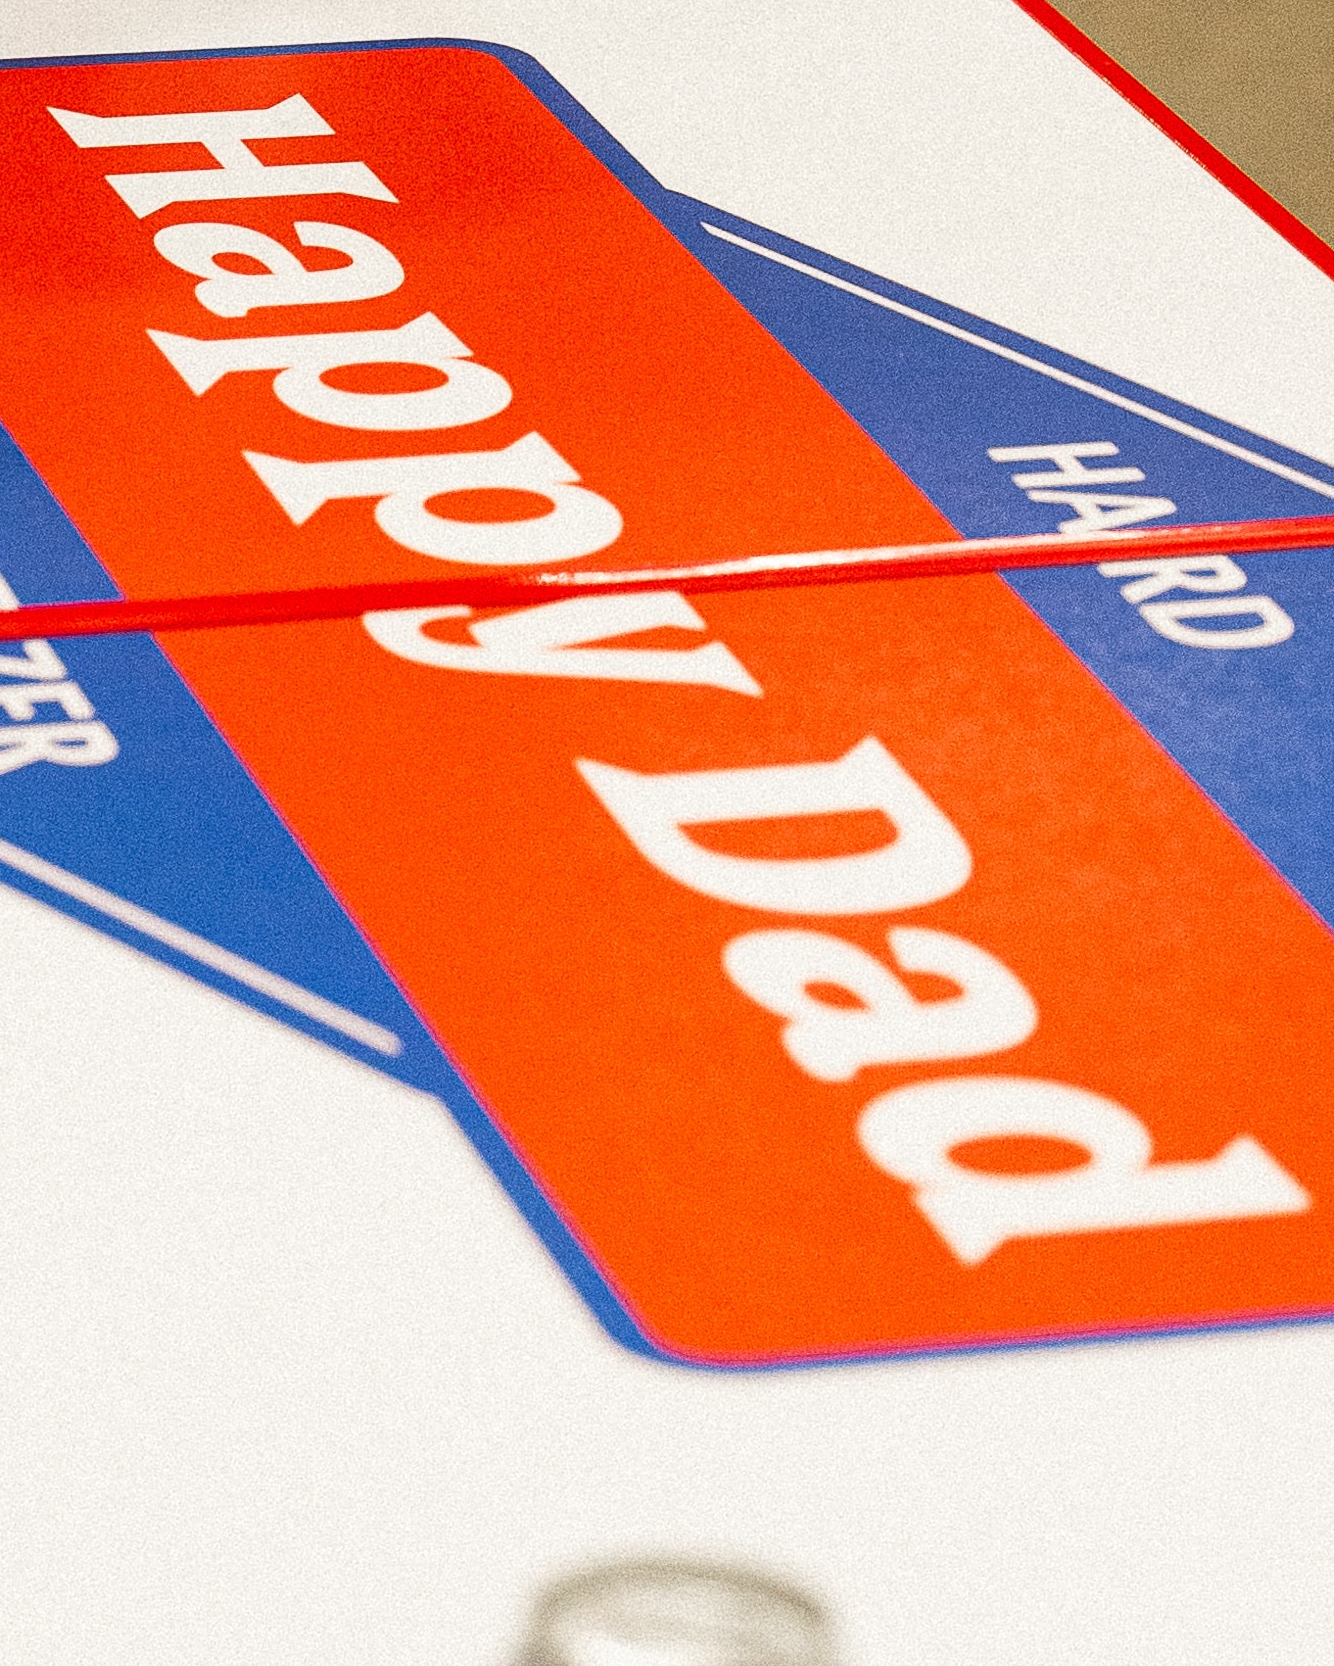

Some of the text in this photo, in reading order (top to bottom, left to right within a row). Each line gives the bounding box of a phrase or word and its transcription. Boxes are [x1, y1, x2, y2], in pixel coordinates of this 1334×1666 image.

[45, 91, 763, 697] Happy
[573, 735, 1312, 1268] Dad
[986, 440, 1296, 650] HARD
